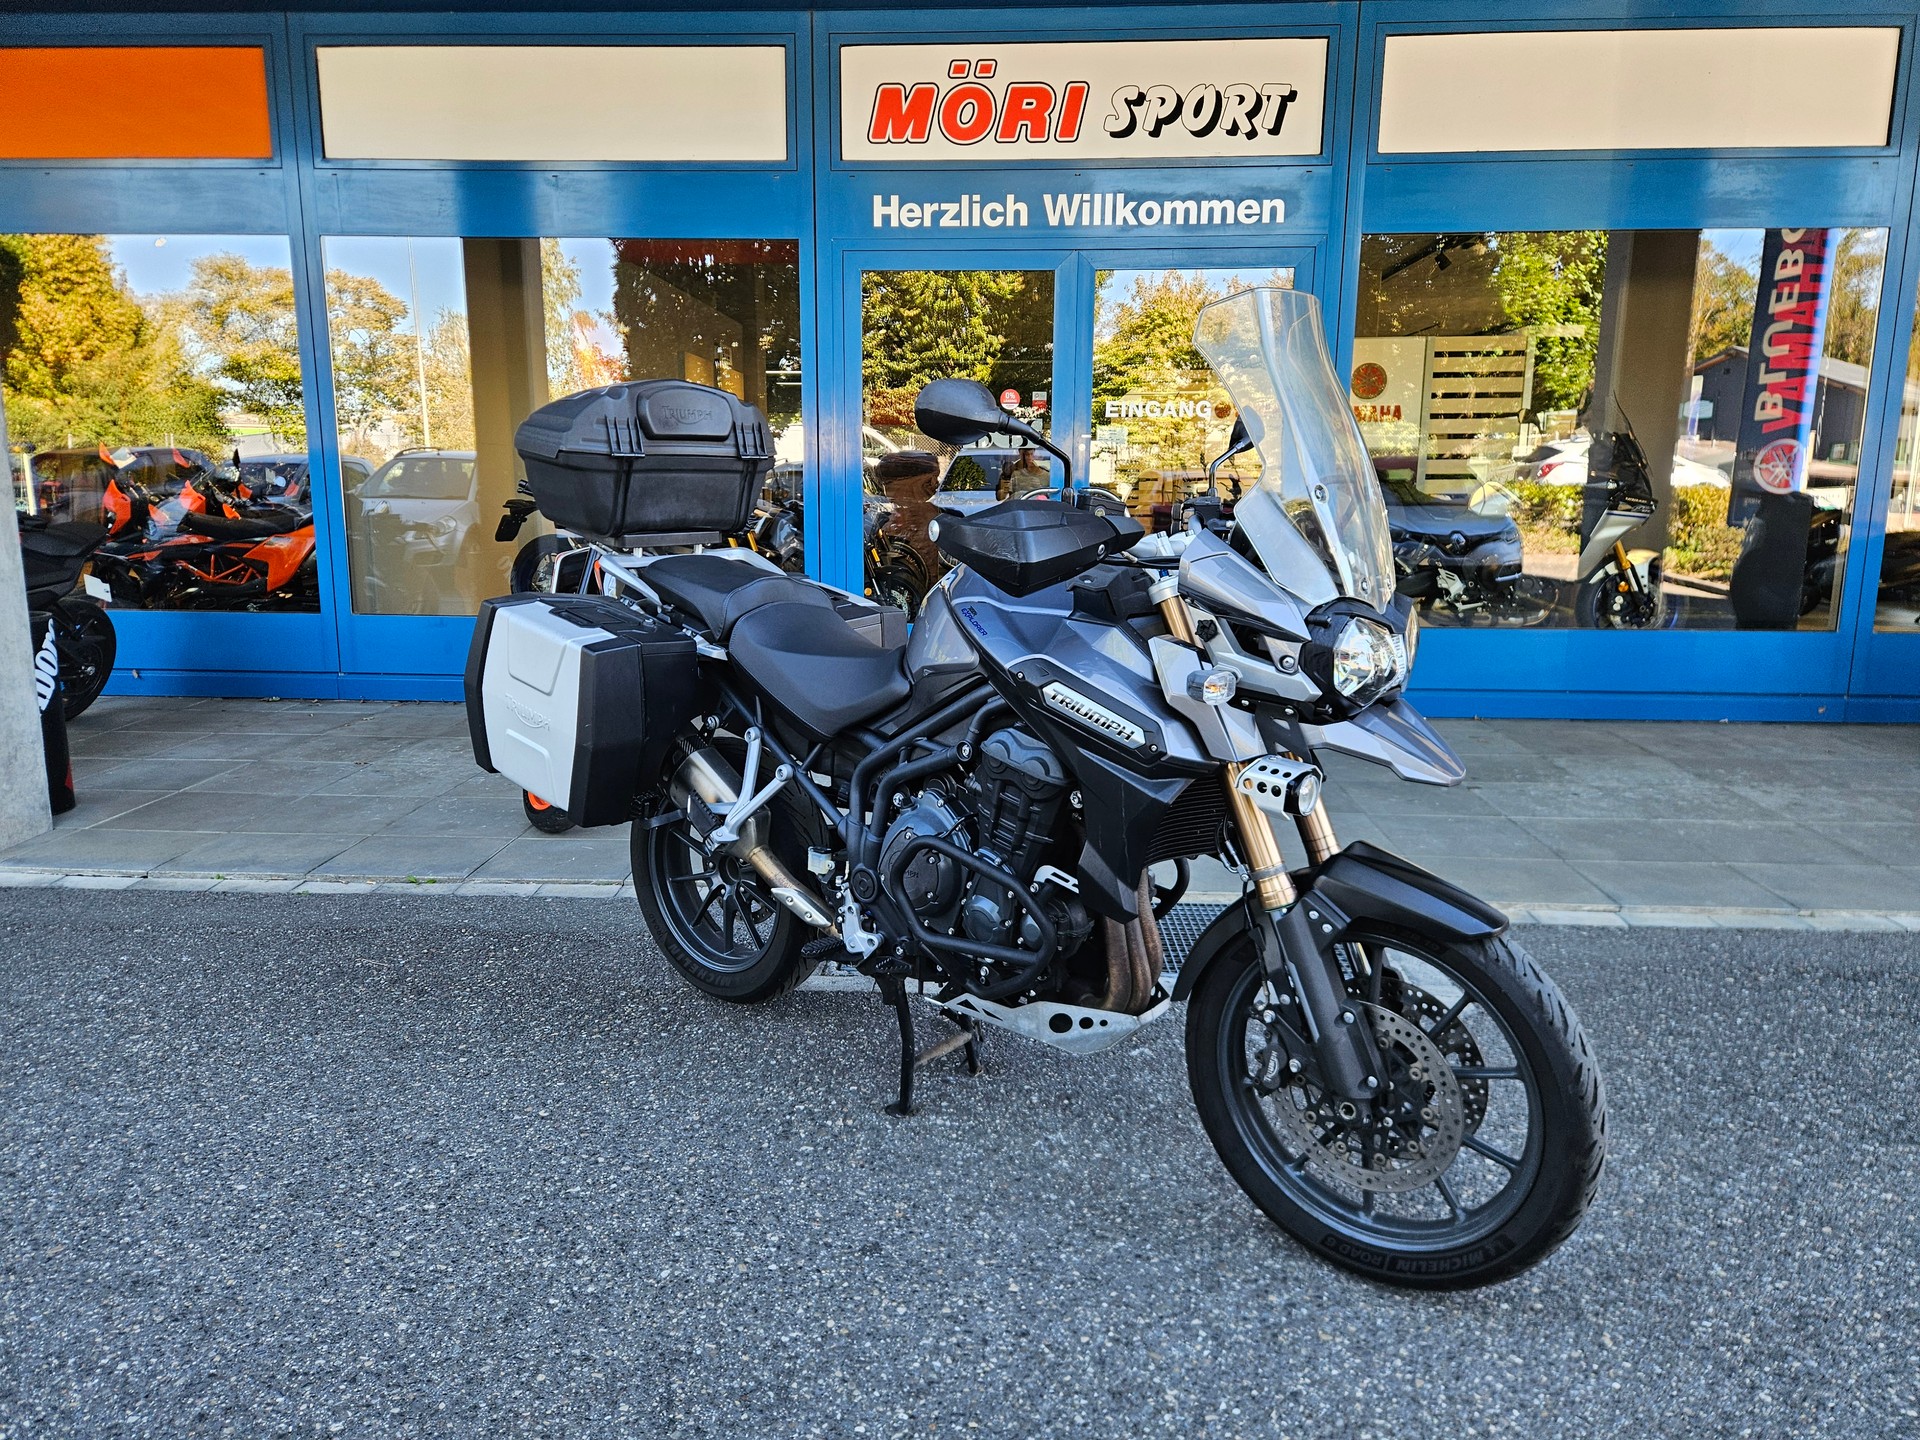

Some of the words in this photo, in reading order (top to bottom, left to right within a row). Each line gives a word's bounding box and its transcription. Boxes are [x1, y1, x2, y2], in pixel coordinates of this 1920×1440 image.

[867, 59, 1090, 145] MÖRI
[1103, 83, 1298, 140] SPORT
[873, 194, 1028, 227] Herzlich
[1043, 193, 1285, 227] Willkommen
[662, 405, 712, 421] TRIUMPH
[1105, 400, 1212, 420] EINGANG
[961, 607, 988, 636] EXPLORER
[1050, 688, 1135, 741] TRIUMPH
[668, 943, 733, 987] MICHELIN
[1338, 1244, 1382, 1265] ROAD
[1396, 1248, 1485, 1272] MICHELIN
